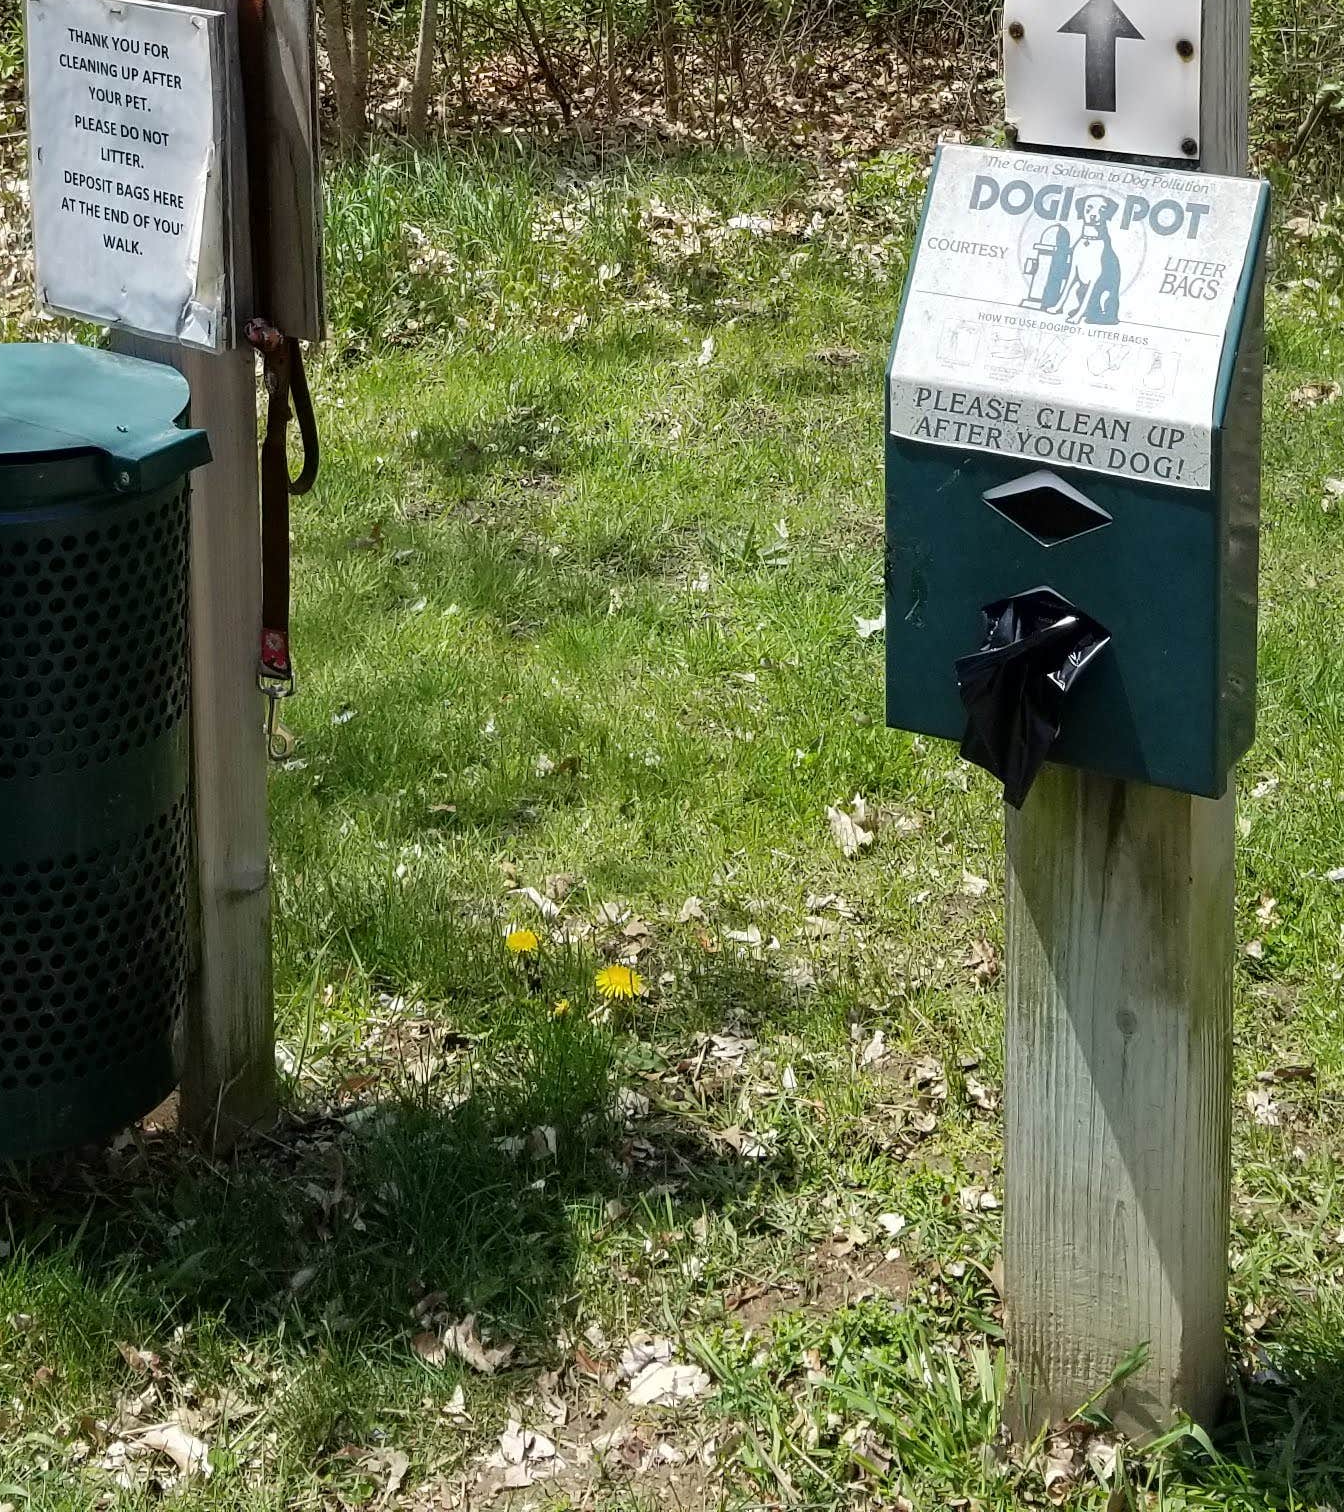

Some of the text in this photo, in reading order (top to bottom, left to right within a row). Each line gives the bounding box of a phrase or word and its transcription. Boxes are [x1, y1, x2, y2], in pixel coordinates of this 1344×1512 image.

[68, 28, 170, 60] THANK YOU FOR
[59, 54, 182, 90] CLEANING UP AFTER
[89, 86, 152, 113] YOUR PET.
[75, 115, 170, 147] PLEASE DO NOT
[101, 148, 144, 169] LITTER.
[1013, 159, 1049, 174] Clean
[1052, 163, 1104, 180] Solution
[1108, 172, 1119, 182] to
[1122, 173, 1149, 189] Dog
[64, 170, 184, 209] DEPOSIT BAGS HERE
[61, 197, 77, 213] AT
[79, 201, 101, 219] THE
[103, 207, 129, 225] END
[133, 214, 150, 230] OF
[103, 234, 143, 256] WALK.
[927, 237, 1008, 259] COURTESY
[1164, 256, 1227, 279] LITTER
[1159, 274, 1220, 301] BAGS
[978, 311, 1000, 323] HOW
[1002, 315, 1017, 326] TO
[1019, 317, 1037, 328] USE
[1088, 328, 1120, 341] LITTER
[1122, 333, 1149, 346] BAGS
[915, 386, 1185, 450] PLEASE CLEAN UP
[915, 417, 1185, 480] AFTER YOUR DOG!
